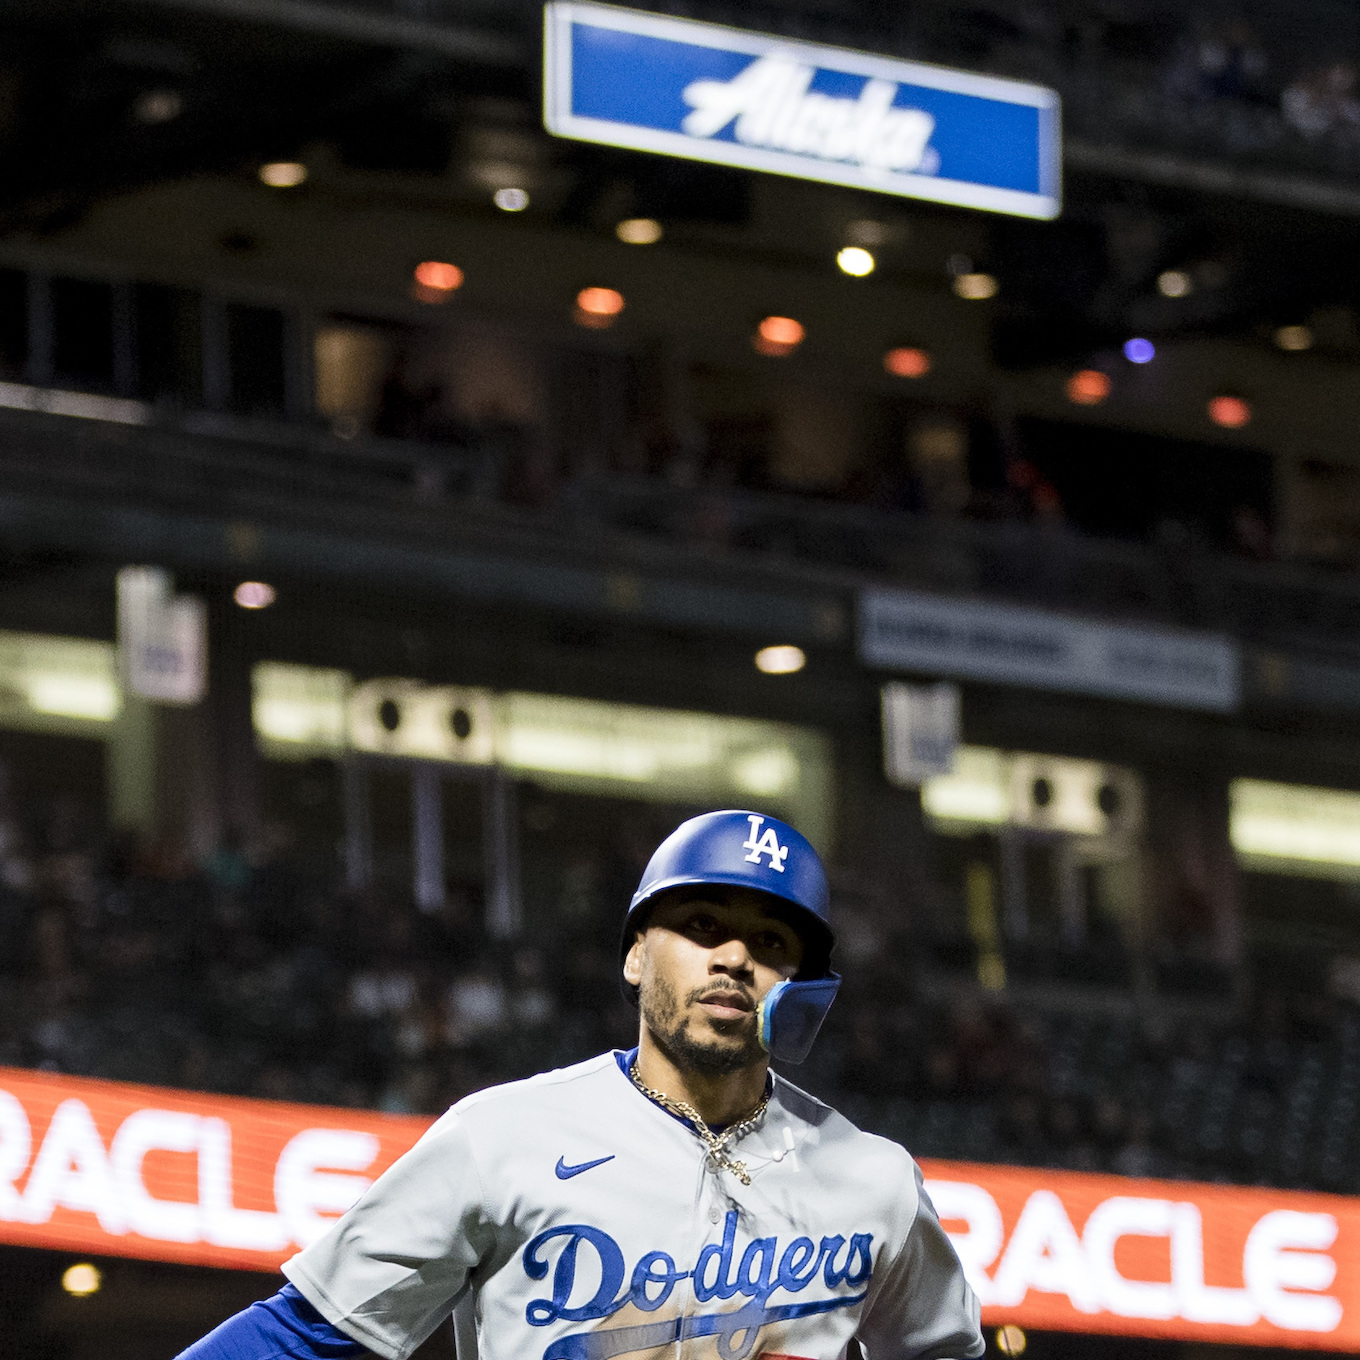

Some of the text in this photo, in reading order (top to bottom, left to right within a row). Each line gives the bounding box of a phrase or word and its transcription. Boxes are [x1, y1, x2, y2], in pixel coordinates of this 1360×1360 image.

[682, 49, 937, 178] Alaska
[743, 814, 789, 873] LA
[922, 1180, 1343, 1333] RACLE
